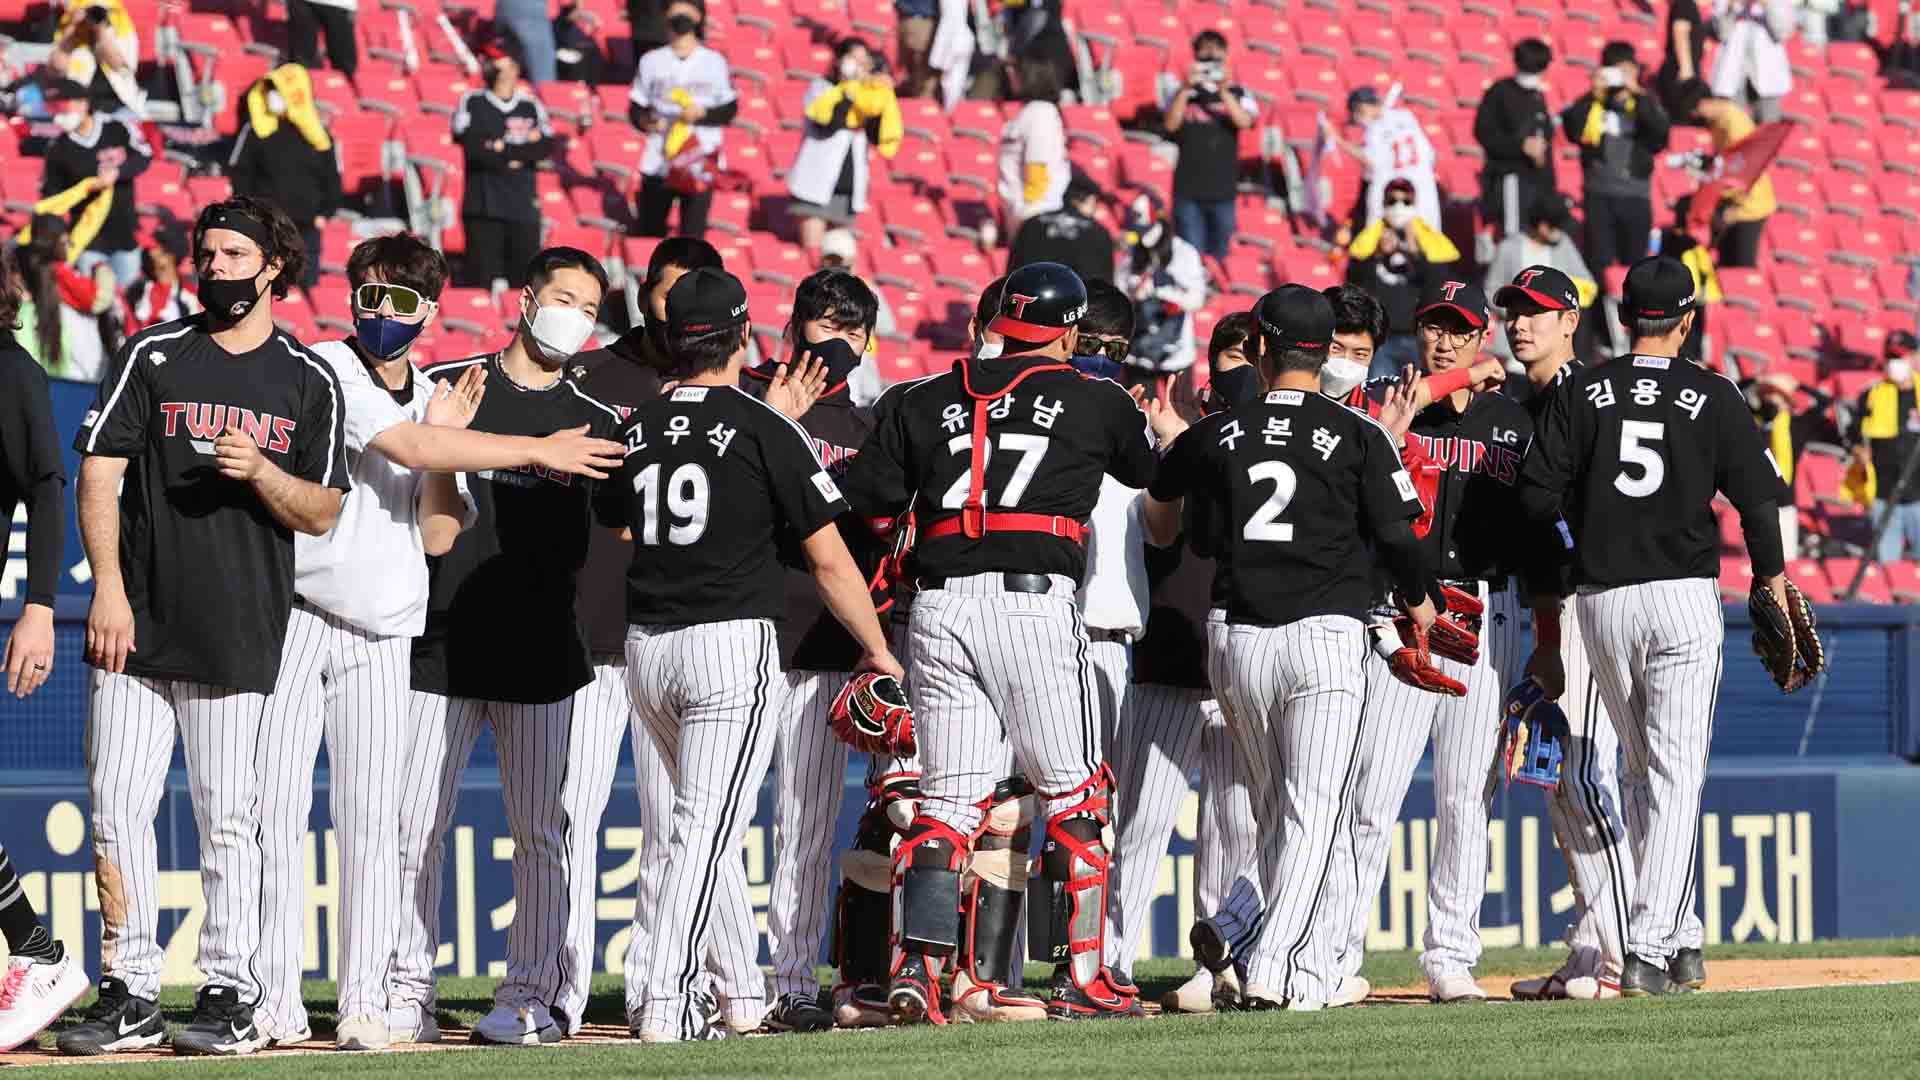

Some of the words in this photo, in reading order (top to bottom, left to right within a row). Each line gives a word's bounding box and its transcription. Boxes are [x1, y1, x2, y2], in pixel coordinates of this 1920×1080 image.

[1440, 281, 1467, 301] T
[1519, 269, 1545, 288] T
[1009, 293, 1039, 319] T
[1063, 311, 1076, 324] LG
[1585, 378, 1708, 421] 김용의
[160, 402, 296, 454] TWINS
[624, 415, 737, 458] 고우석
[1219, 416, 1342, 462] 구본혁
[1492, 426, 1518, 445] LG
[942, 433, 1050, 509] 27
[1613, 420, 1665, 498] 5
[633, 462, 710, 546] 19
[1243, 460, 1297, 542] 2
[900, 967, 916, 977] 27
[1053, 944, 1069, 957] 27
